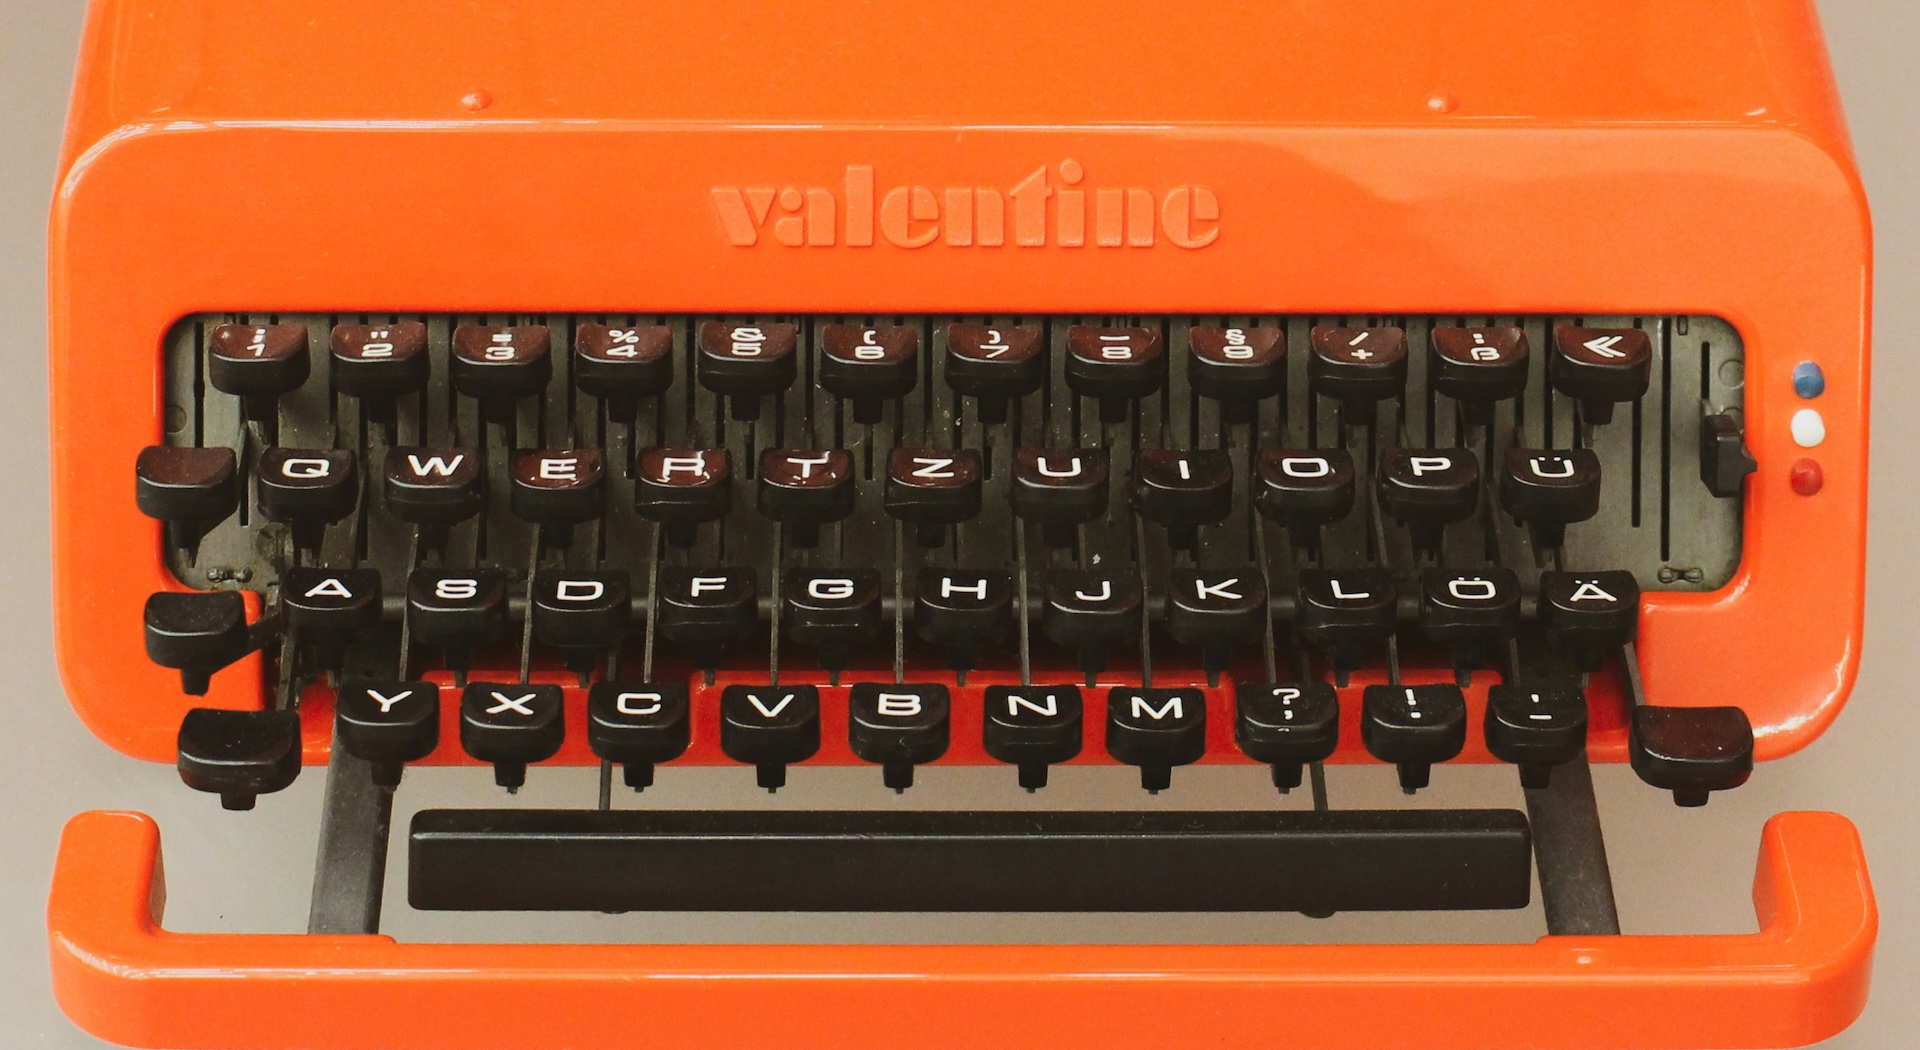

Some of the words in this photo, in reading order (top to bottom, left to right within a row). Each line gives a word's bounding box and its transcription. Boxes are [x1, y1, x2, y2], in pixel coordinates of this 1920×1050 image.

[711, 157, 1220, 249] valentine
[608, 329, 640, 343] %
[246, 343, 265, 357] 1
[361, 342, 393, 357] 2
[485, 346, 515, 360] 3
[606, 344, 639, 358] 4
[731, 342, 762, 356] 5
[854, 345, 885, 360] 6
[979, 344, 1009, 359] 7
[1101, 346, 1132, 359] 8
[1222, 345, 1254, 359] 9
[1350, 348, 1374, 360] +
[282, 458, 330, 479] Q
[407, 454, 464, 477] W
[540, 458, 578, 479] E
[661, 457, 706, 481] R
[787, 457, 829, 478] T
[911, 457, 955, 478] Z
[1037, 456, 1082, 478] U
[1178, 459, 1191, 480] I
[1281, 457, 1336, 478] O
[1410, 456, 1452, 477] P
[1529, 456, 1575, 478] Ü
[304, 578, 353, 599] A
[435, 579, 478, 599] S
[556, 580, 604, 601] D
[690, 576, 728, 598] F
[808, 578, 854, 599] G
[941, 577, 987, 600] H
[1075, 580, 1111, 601] J
[1195, 578, 1243, 600] K
[1330, 579, 1370, 599] L
[1448, 576, 1497, 600] Ö
[1569, 578, 1618, 602] Ä
[366, 689, 413, 713] Y
[485, 691, 537, 716] X
[616, 692, 662, 715] C
[746, 694, 795, 718] V
[877, 692, 922, 716] B
[1007, 694, 1058, 716] N
[1272, 688, 1301, 706] ?
[1405, 688, 1417, 706] !
[1130, 696, 1183, 720] M
